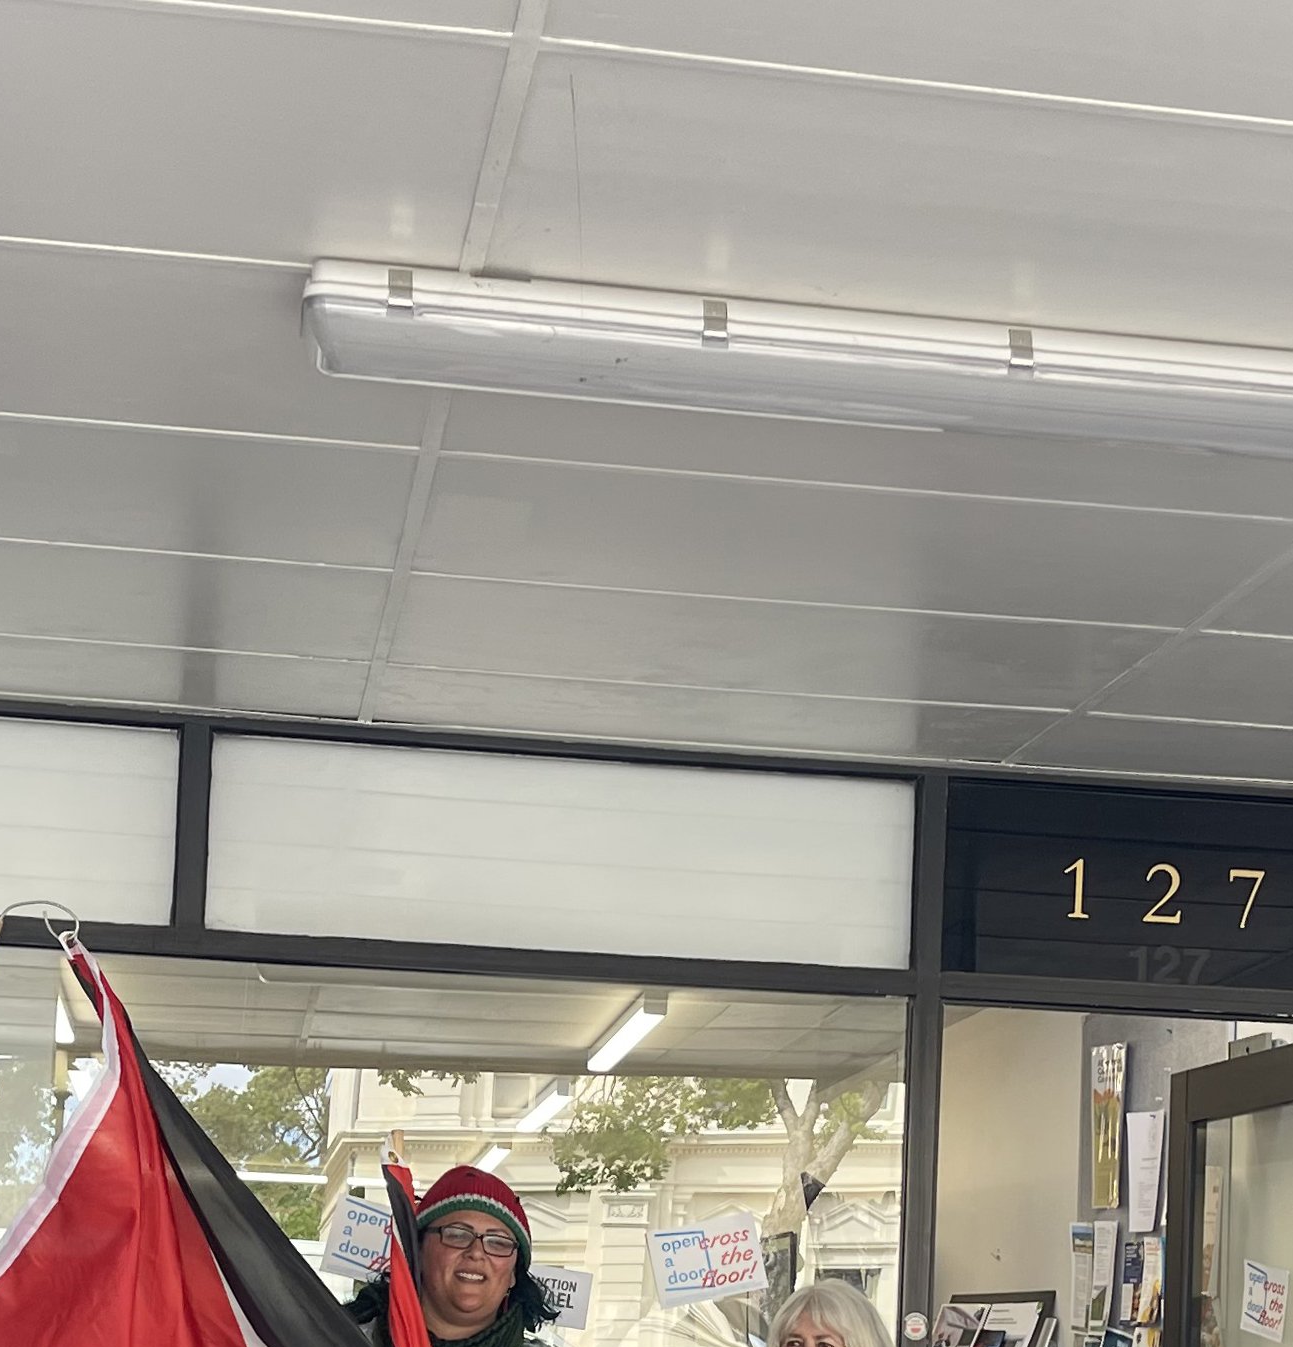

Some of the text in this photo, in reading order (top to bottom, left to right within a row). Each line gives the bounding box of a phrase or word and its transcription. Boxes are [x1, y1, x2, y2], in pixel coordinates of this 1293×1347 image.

[346, 1209, 390, 1232] open
[342, 1224, 353, 1237] a
[699, 1229, 749, 1251] cross
[339, 1241, 380, 1261] door
[661, 1235, 702, 1254] open
[664, 1257, 675, 1268] a
[721, 1246, 754, 1266] the
[667, 1267, 707, 1285] door
[701, 1260, 758, 1289] floor!
[1269, 1297, 1284, 1314] the
